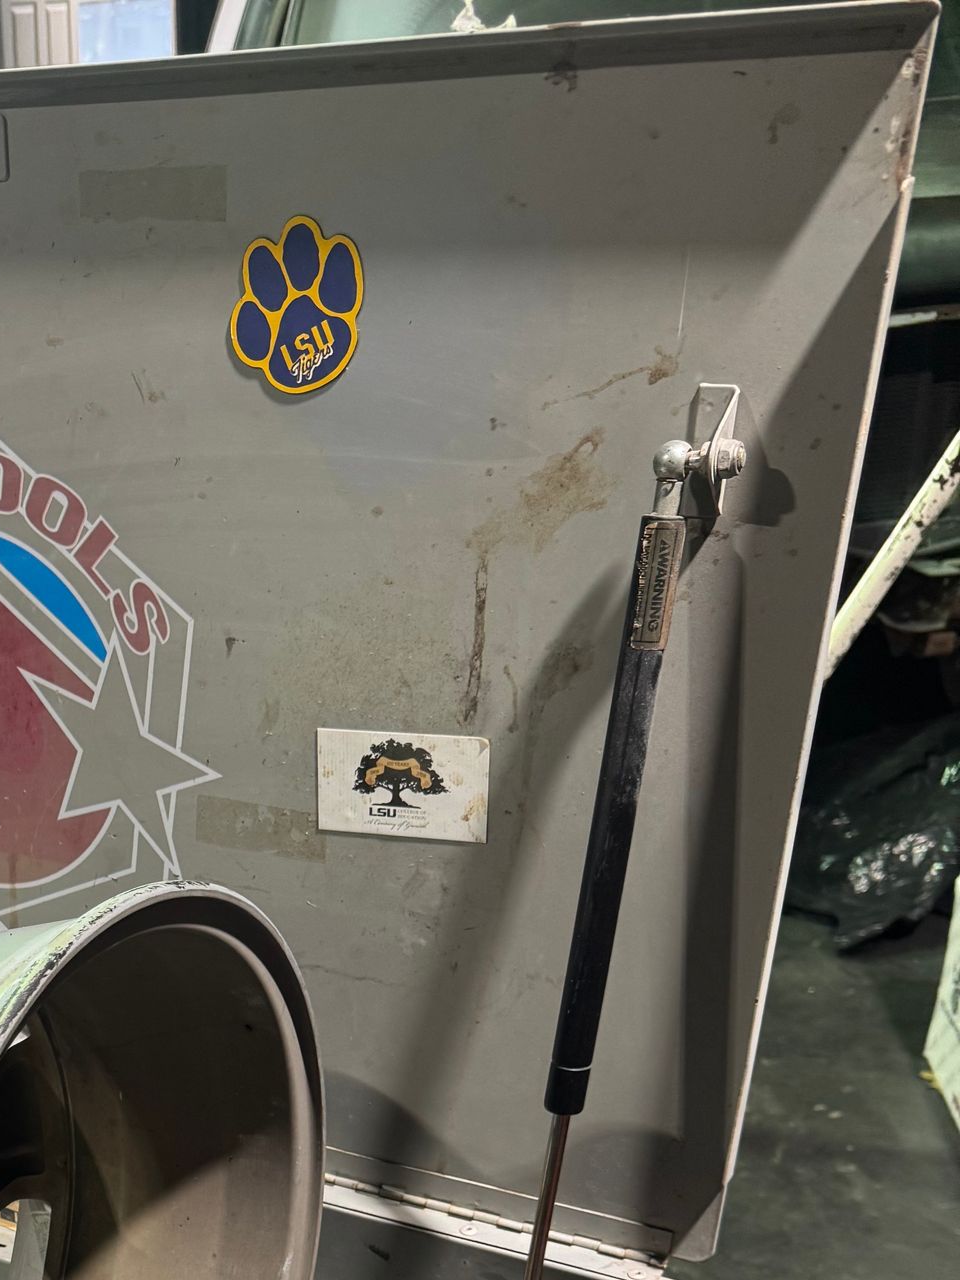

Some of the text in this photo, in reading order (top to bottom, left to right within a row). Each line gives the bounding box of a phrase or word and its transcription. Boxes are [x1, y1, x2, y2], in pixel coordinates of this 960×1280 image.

[280, 319, 335, 371] LSU
[292, 343, 334, 384] Tigers
[647, 549, 671, 633] WARNING
[368, 806, 397, 818] LSU
